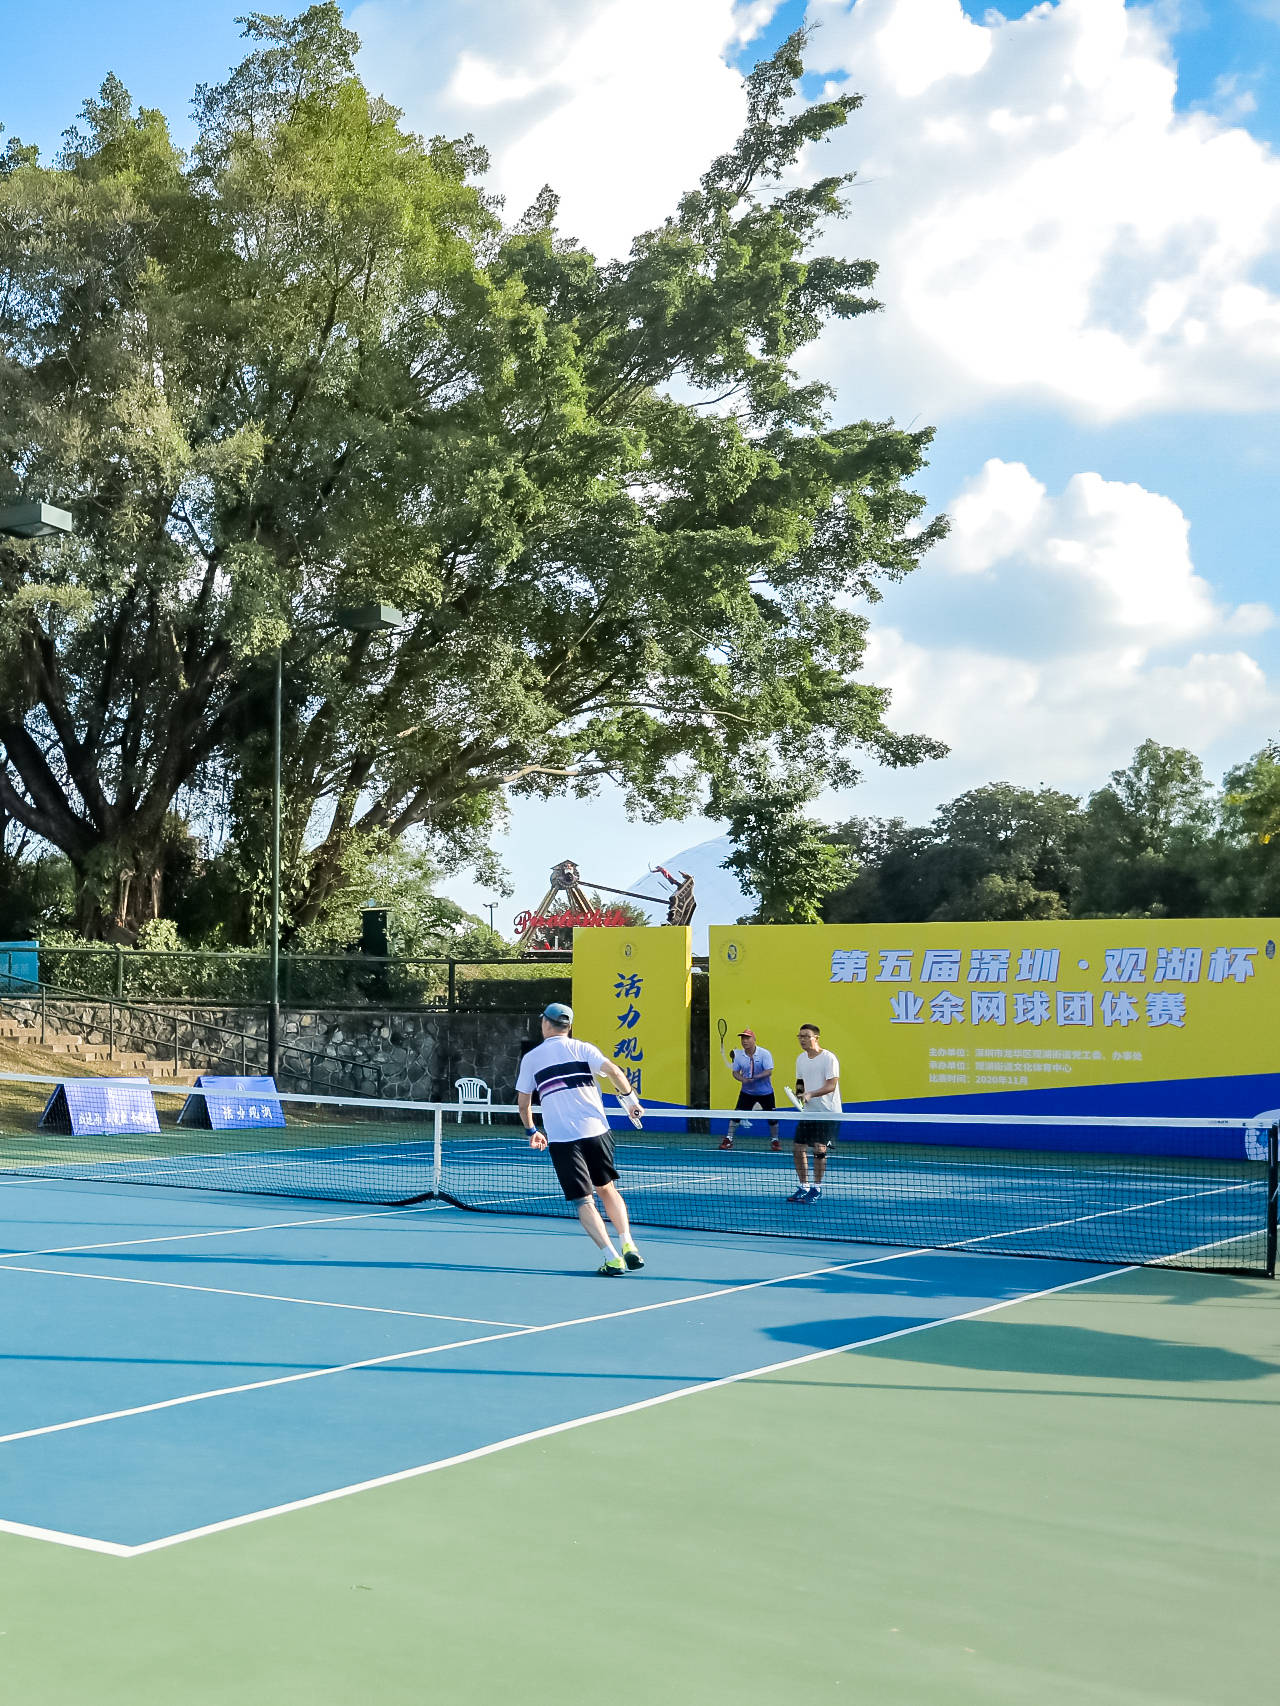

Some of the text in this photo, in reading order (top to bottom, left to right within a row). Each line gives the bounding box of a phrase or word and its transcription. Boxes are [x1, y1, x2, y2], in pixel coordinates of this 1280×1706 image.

[829, 948, 1258, 983] 第五届深圳·观湖杯
[889, 990, 1187, 1027] 业余网球团体赛
